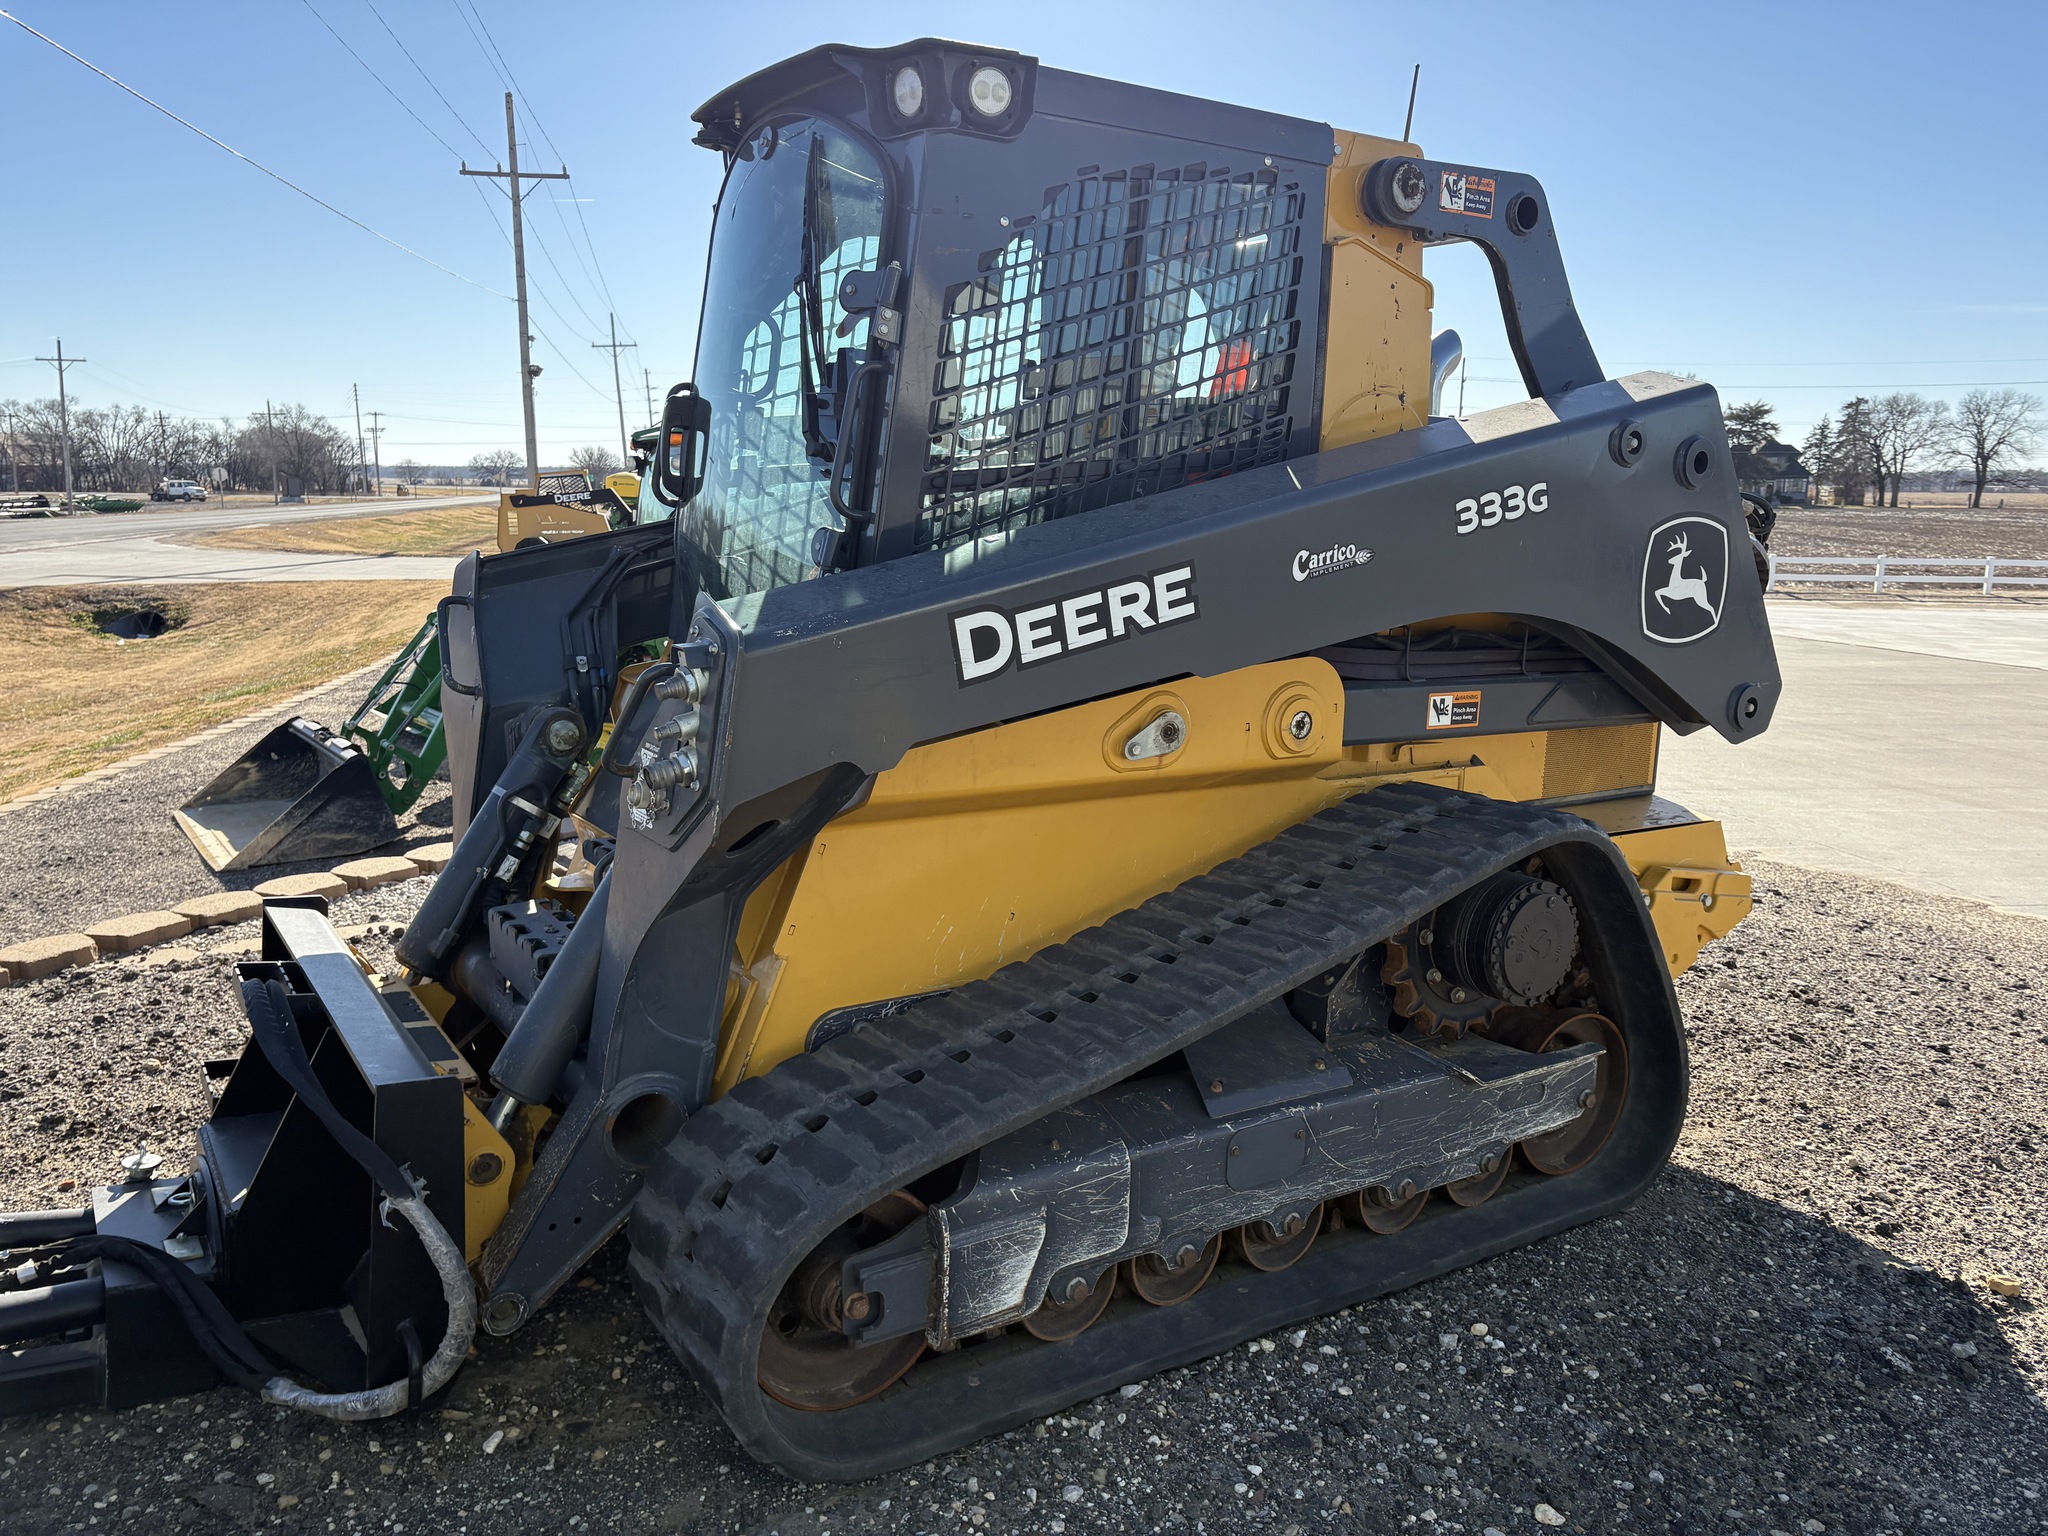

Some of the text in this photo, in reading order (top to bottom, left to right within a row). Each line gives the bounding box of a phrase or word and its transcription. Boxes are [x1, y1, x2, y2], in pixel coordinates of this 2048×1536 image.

[1465, 201, 1487, 211] Keep Away
[1480, 195, 1491, 203] Area
[554, 491, 591, 503] DEERE
[1455, 482, 1548, 534] 333G
[1292, 543, 1356, 582] Carrico
[1310, 561, 1354, 578] IMPLEMENT
[954, 566, 1196, 681] DEERE
